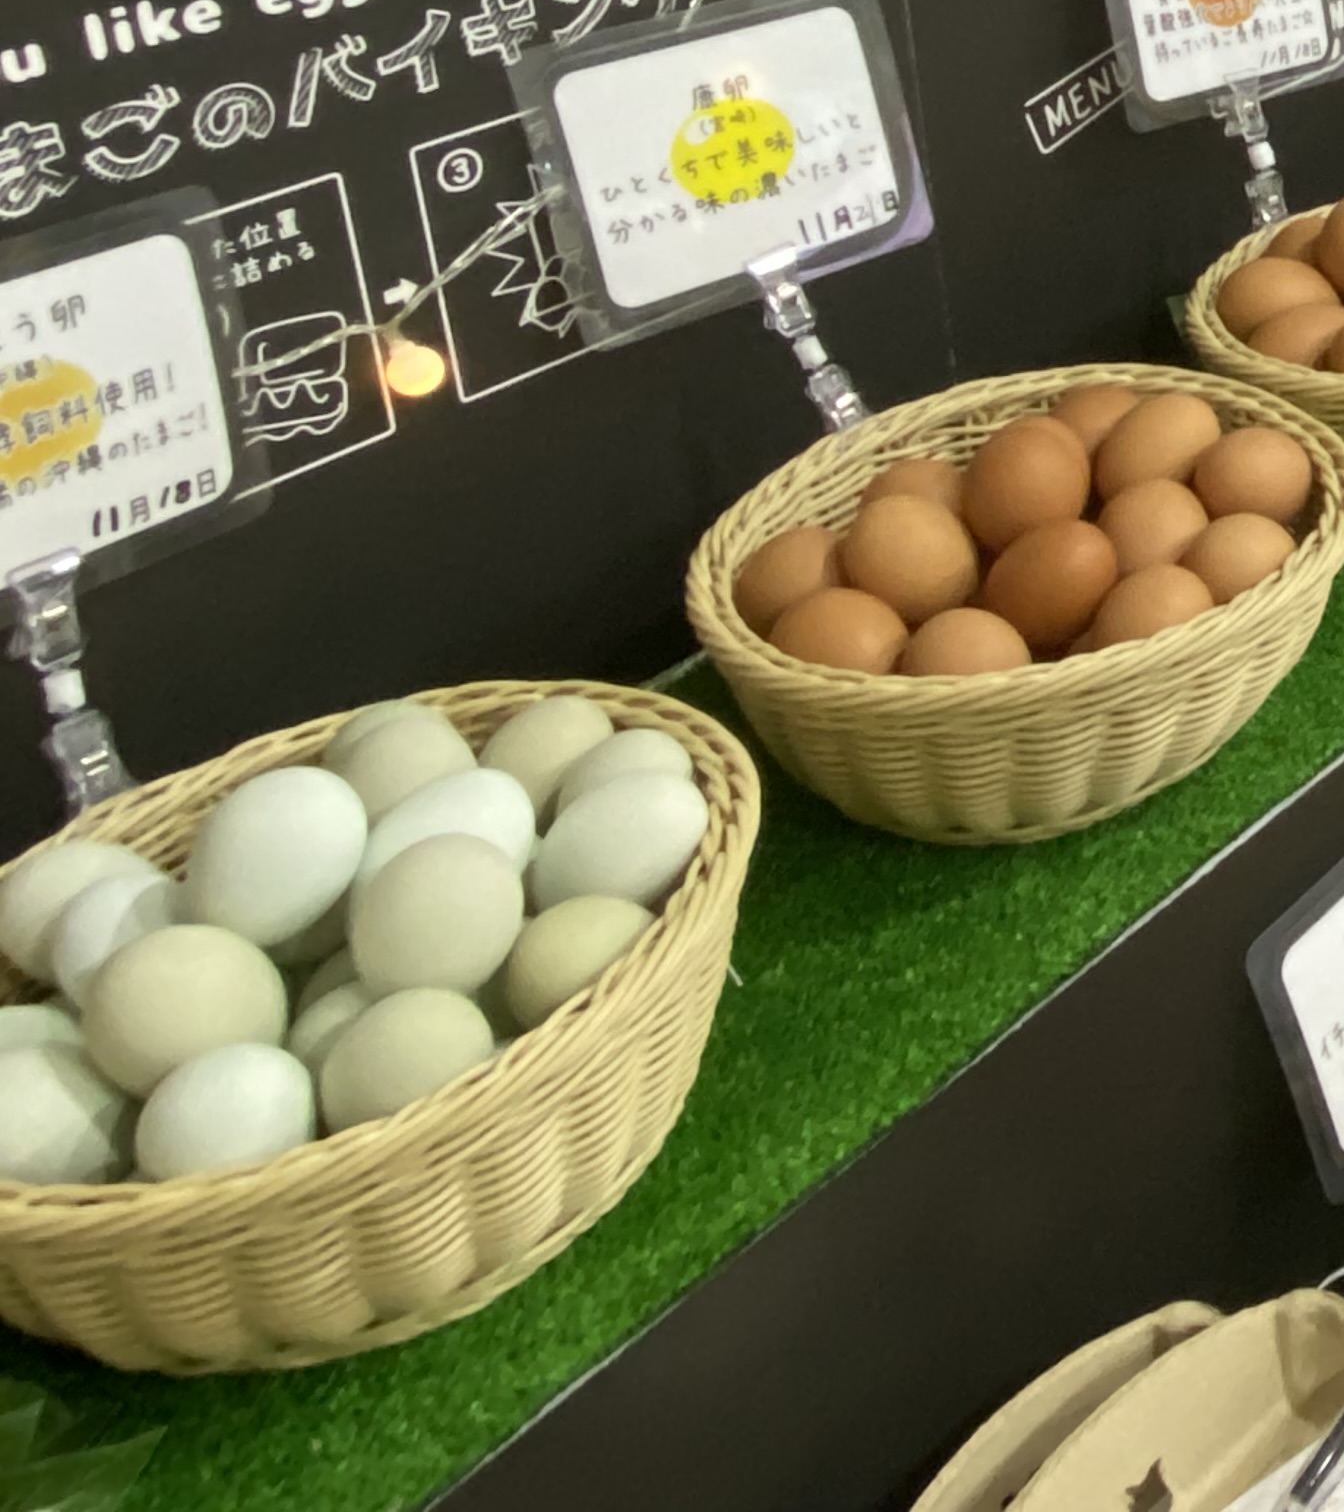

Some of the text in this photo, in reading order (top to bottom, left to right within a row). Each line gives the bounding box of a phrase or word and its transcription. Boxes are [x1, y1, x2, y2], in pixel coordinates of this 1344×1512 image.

[0, 42, 46, 83] u
[1044, 51, 1133, 138] MENU
[0, 294, 86, 349] う卵
